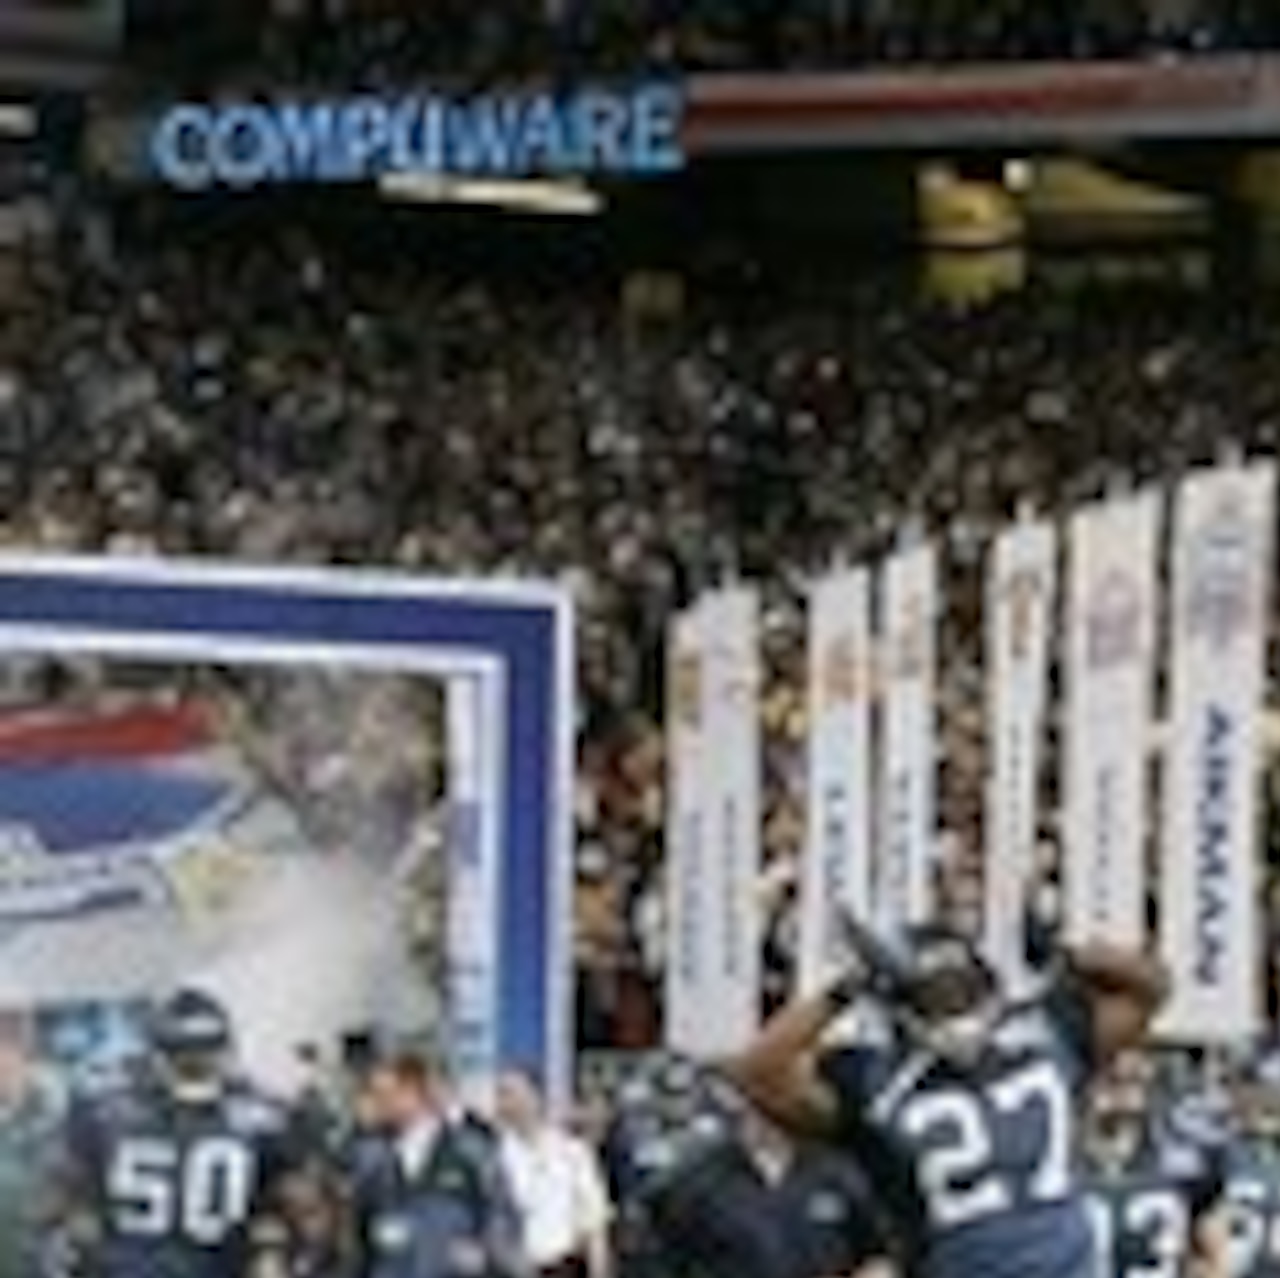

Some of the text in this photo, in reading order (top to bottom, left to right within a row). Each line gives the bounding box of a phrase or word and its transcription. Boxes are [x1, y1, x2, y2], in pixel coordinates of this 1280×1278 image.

[150, 84, 687, 187] COMPUWARE
[109, 1136, 254, 1241] 50
[902, 1059, 1074, 1225] 27
